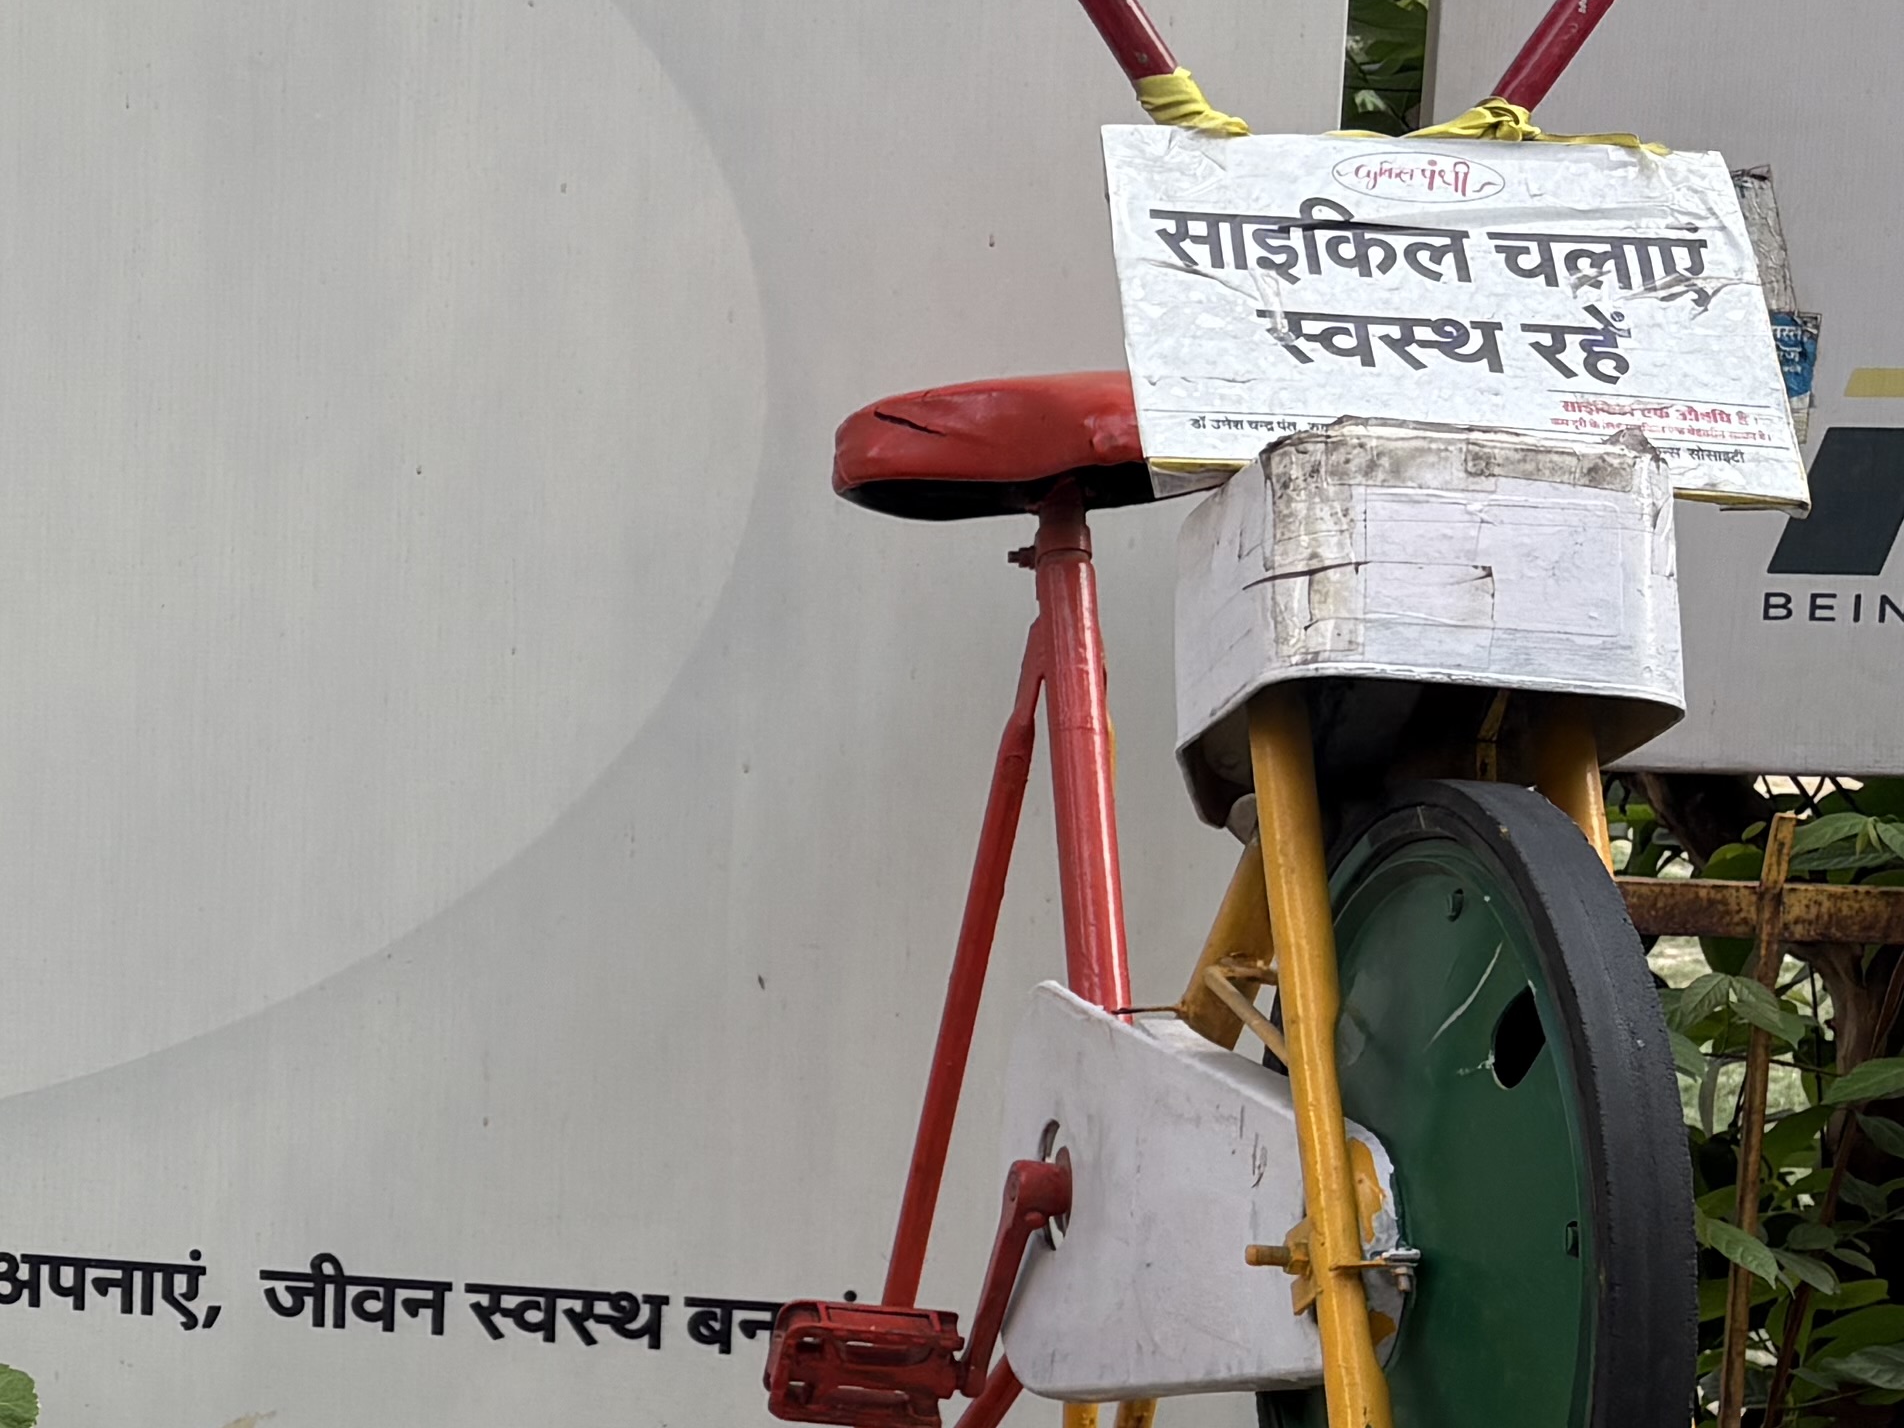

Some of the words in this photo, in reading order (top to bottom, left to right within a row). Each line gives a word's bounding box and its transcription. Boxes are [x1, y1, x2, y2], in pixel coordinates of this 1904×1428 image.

[1150, 196, 1471, 284] साइकिल
[1487, 225, 1715, 312] चलाएं
[1257, 309, 1505, 373] स्वस्थ
[1520, 302, 1632, 385] रहें
[1687, 445, 1745, 464] सोसाइटी
[259, 1252, 452, 1336] जीवन
[465, 1280, 669, 1351] स्वस्थ
